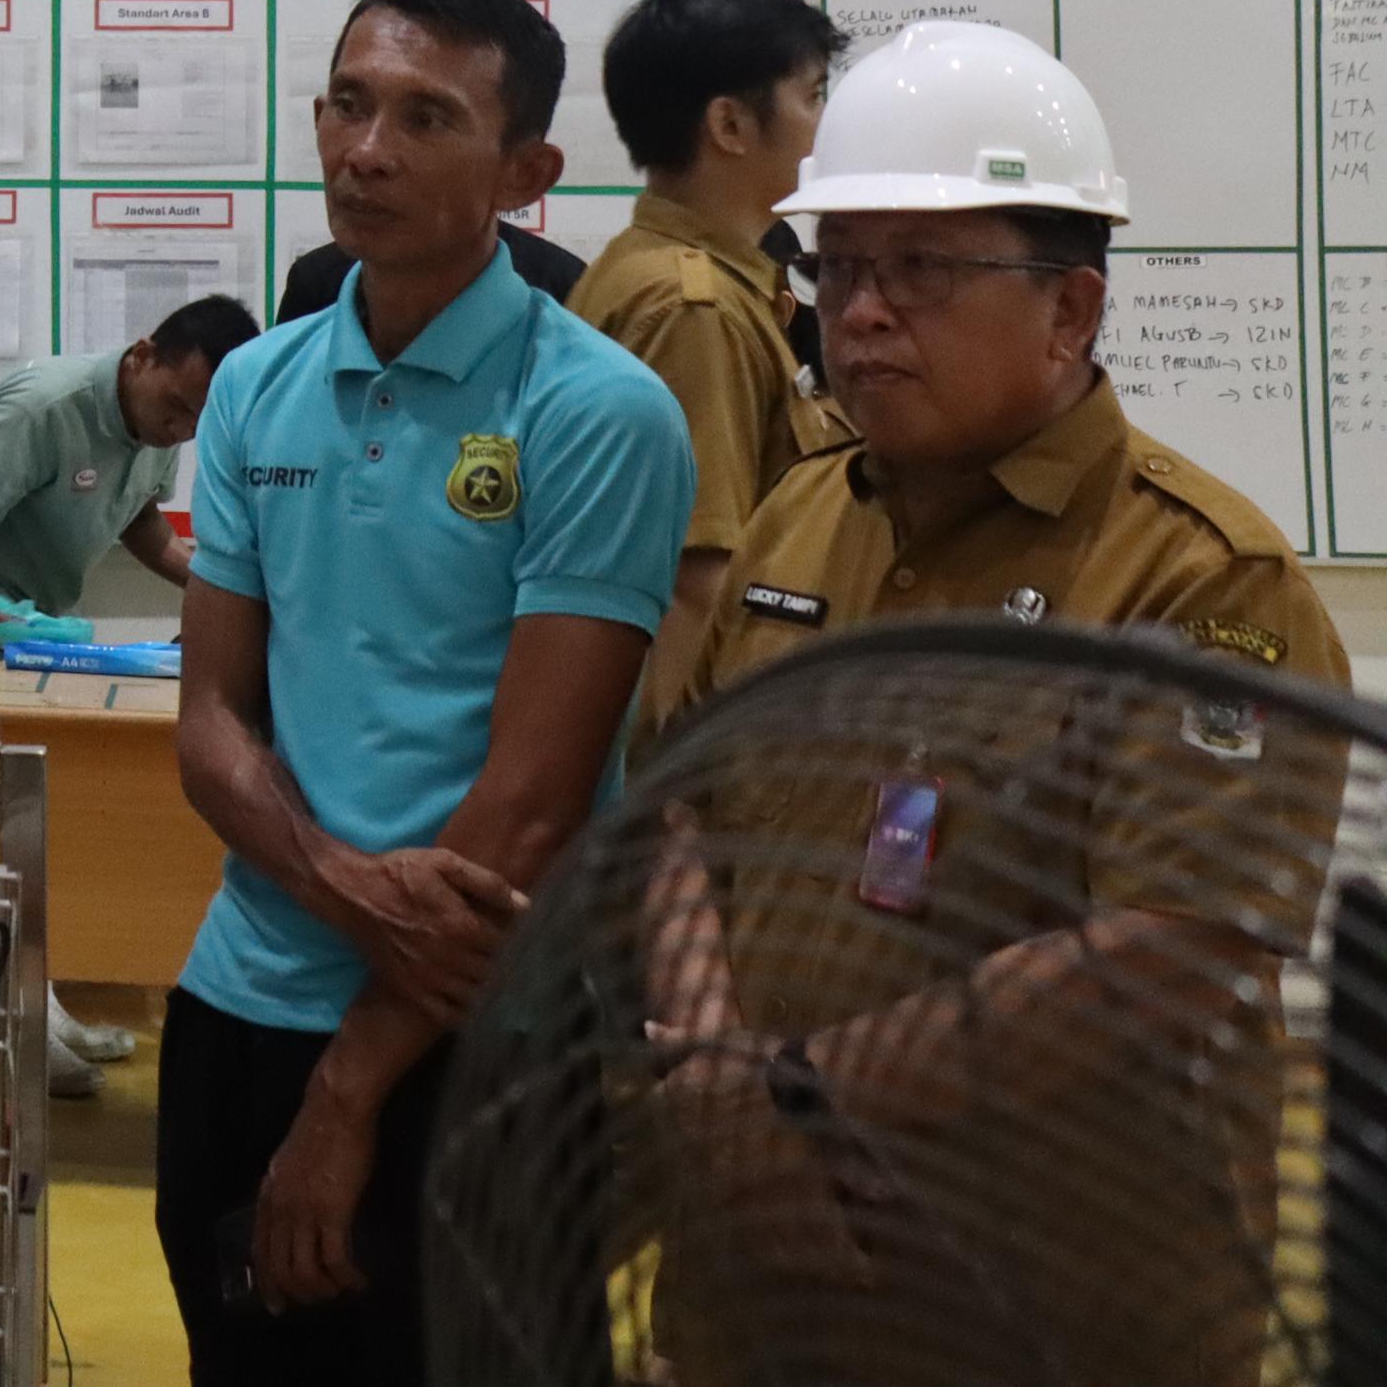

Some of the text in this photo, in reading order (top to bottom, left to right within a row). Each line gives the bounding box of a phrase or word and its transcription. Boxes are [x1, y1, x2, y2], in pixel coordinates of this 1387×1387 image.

[117, 7, 211, 19] Standart Area B
[124, 205, 201, 216] Jadwal Audit
[1145, 255, 1202, 267] OTHERS
